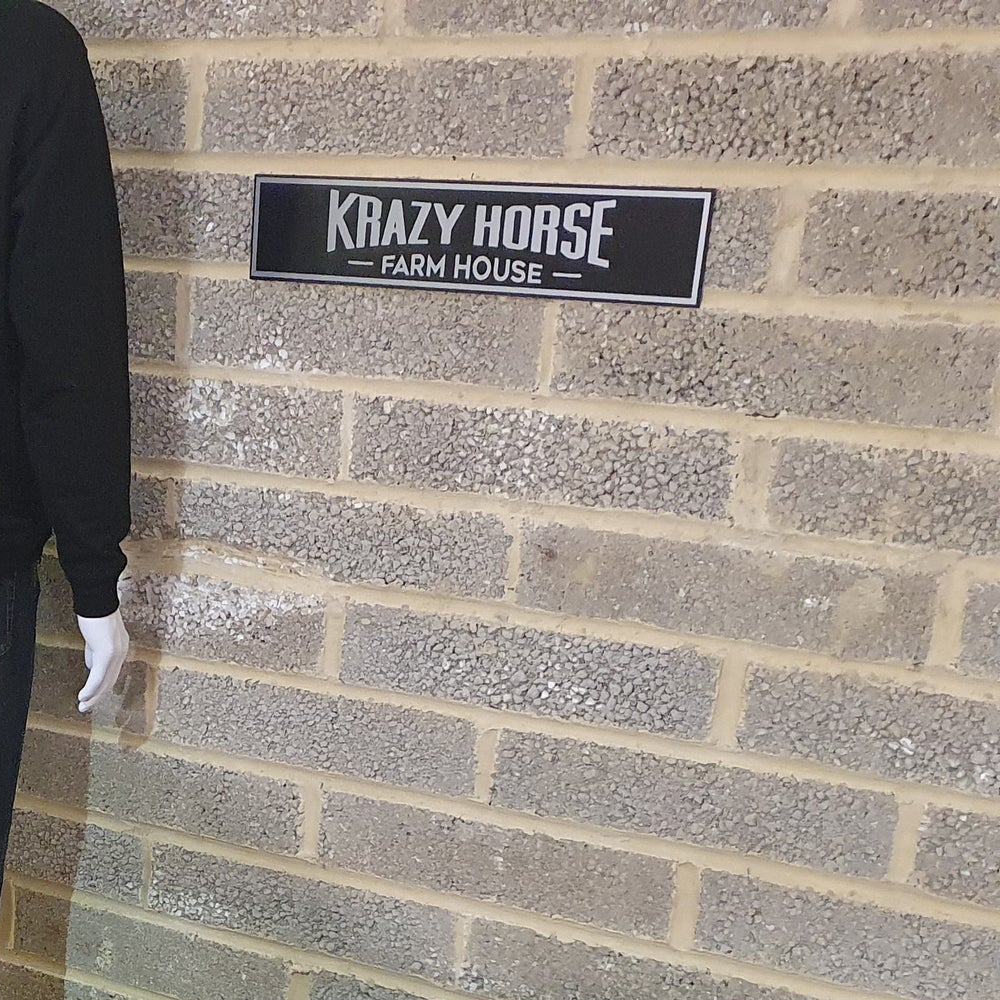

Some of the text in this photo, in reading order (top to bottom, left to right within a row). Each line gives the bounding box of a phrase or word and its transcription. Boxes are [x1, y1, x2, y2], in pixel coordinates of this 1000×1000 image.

[326, 188, 617, 269] KRAZY HORSE
[381, 253, 544, 285] FARM HOUSE
